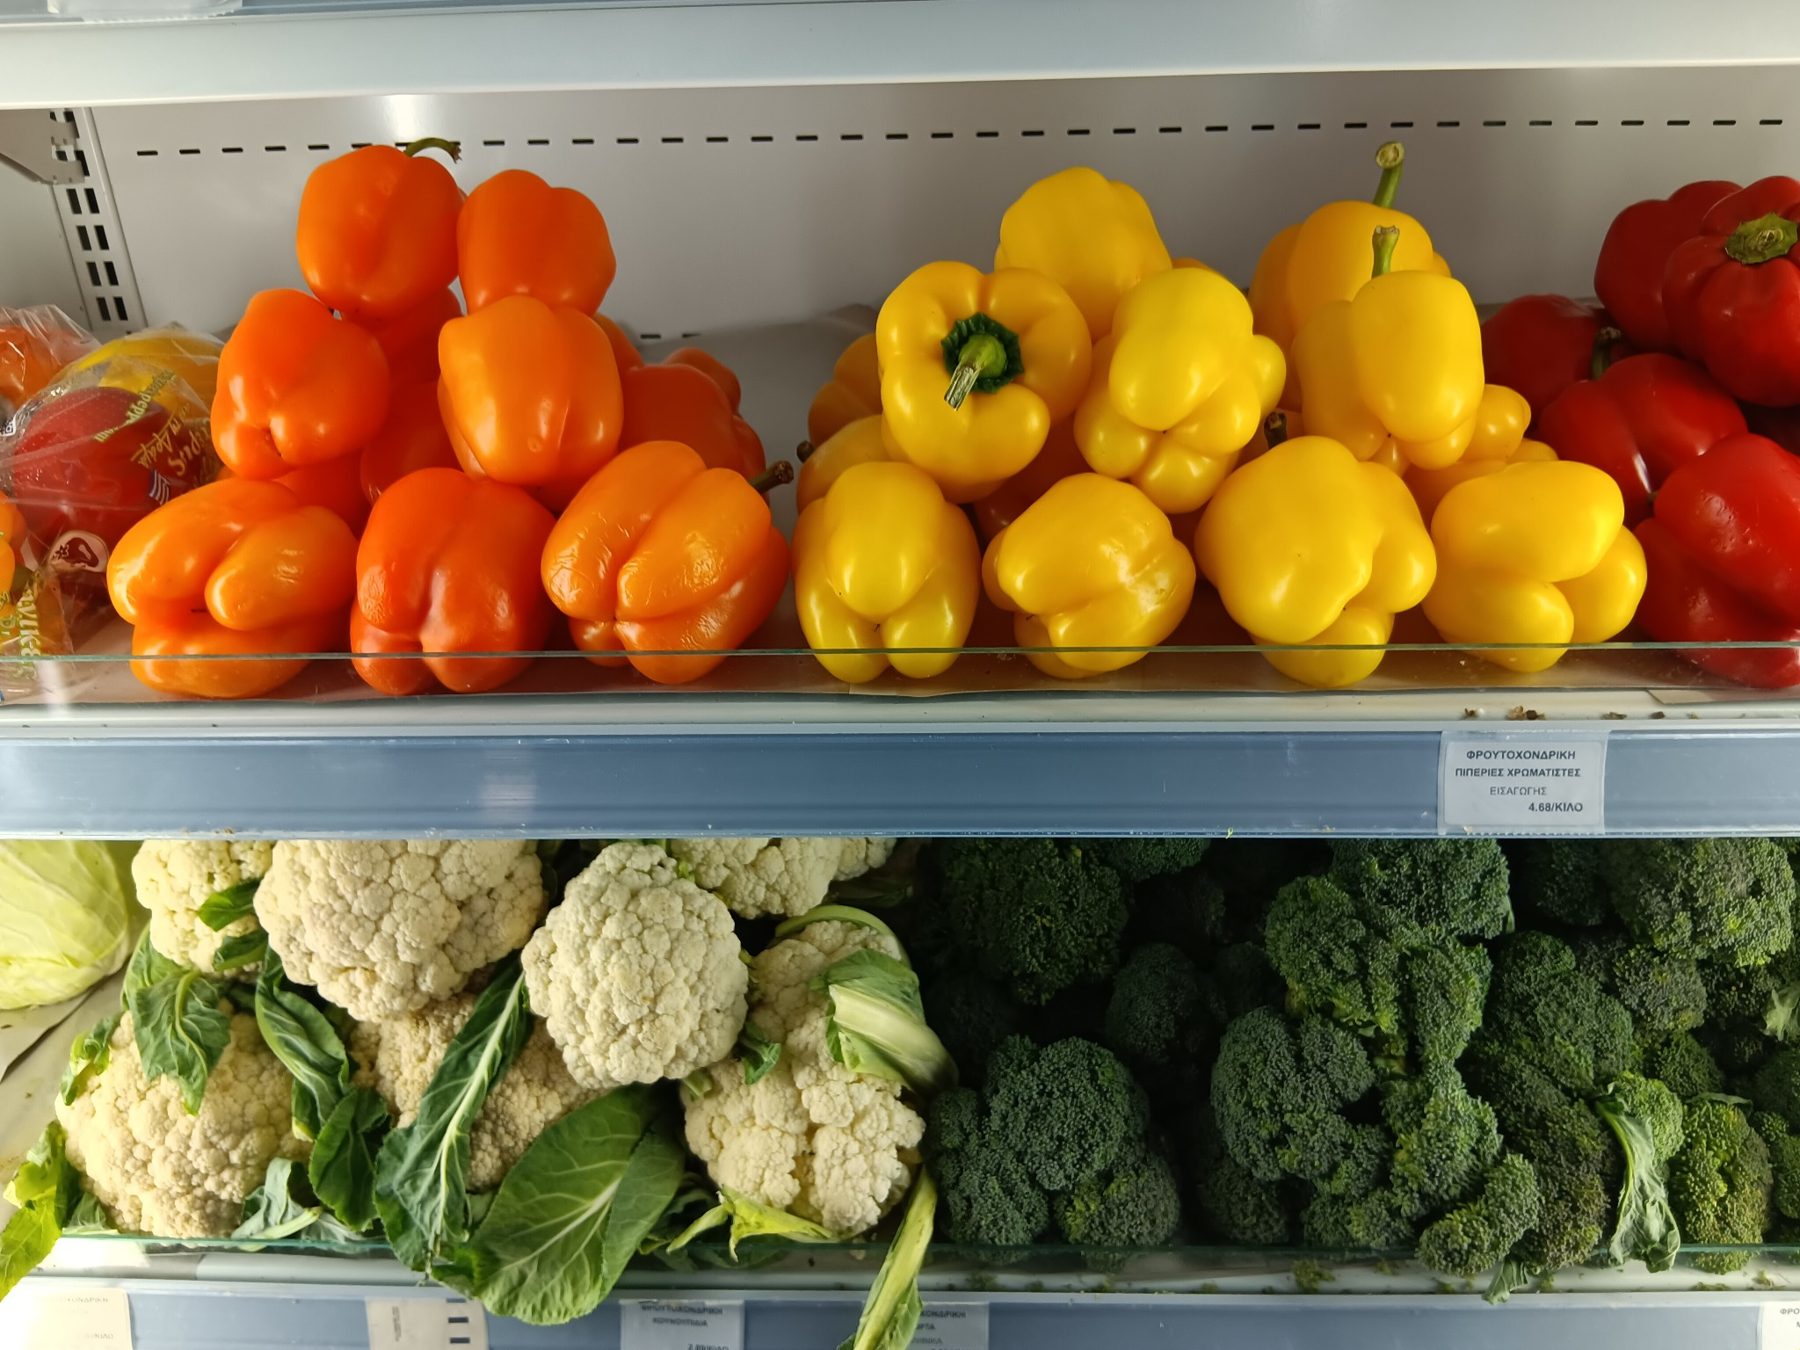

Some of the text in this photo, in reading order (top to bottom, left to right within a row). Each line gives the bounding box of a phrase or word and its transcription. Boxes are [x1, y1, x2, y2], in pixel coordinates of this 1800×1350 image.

[1466, 750, 1576, 760] ΦΡΟΥΤΟΧΟΝΔΡΙΚΗ
[1455, 768, 1581, 777] ΠΙΠΕΡΙΕΣ ΧΡΩΜΑΤΙΣΤΕΣ
[1489, 786, 1547, 796] ΕΙΣΑΓΩΓΗΣ
[1528, 802, 1583, 812] 4.68/ΚΙΛΟ
